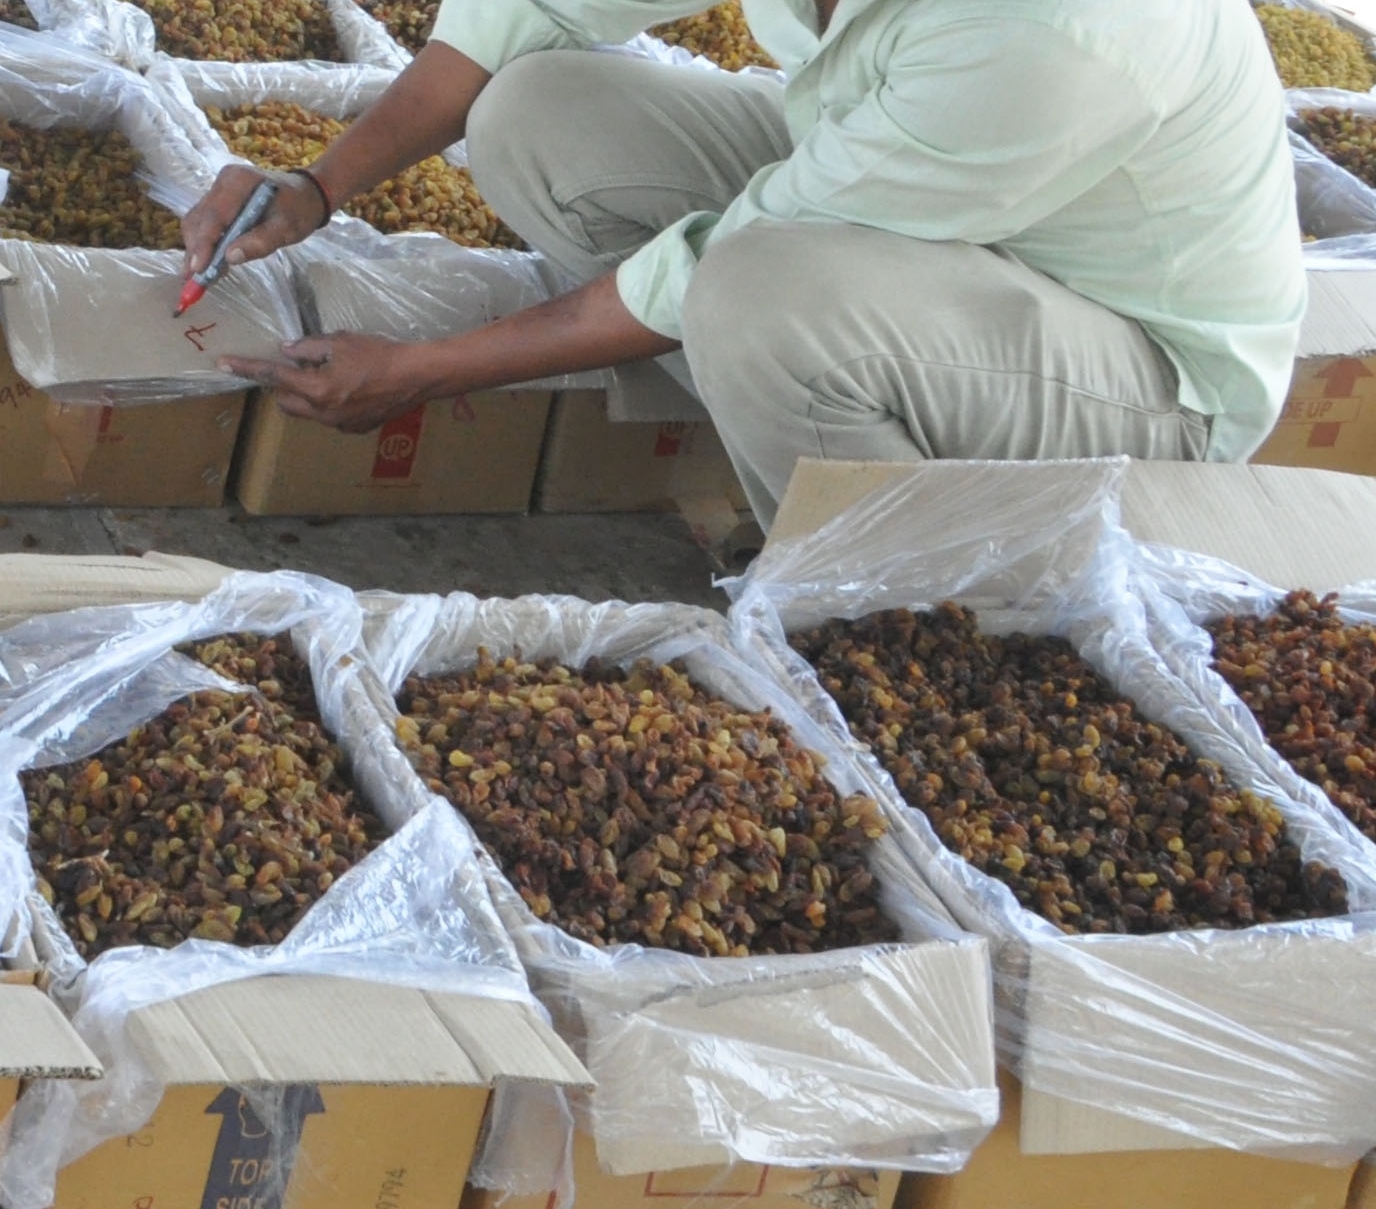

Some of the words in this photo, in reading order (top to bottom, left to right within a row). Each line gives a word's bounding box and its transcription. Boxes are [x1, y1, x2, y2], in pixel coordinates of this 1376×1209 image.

[1307, 400, 1334, 418] UP
[383, 438, 413, 459] UP
[228, 1158, 274, 1185] TOP
